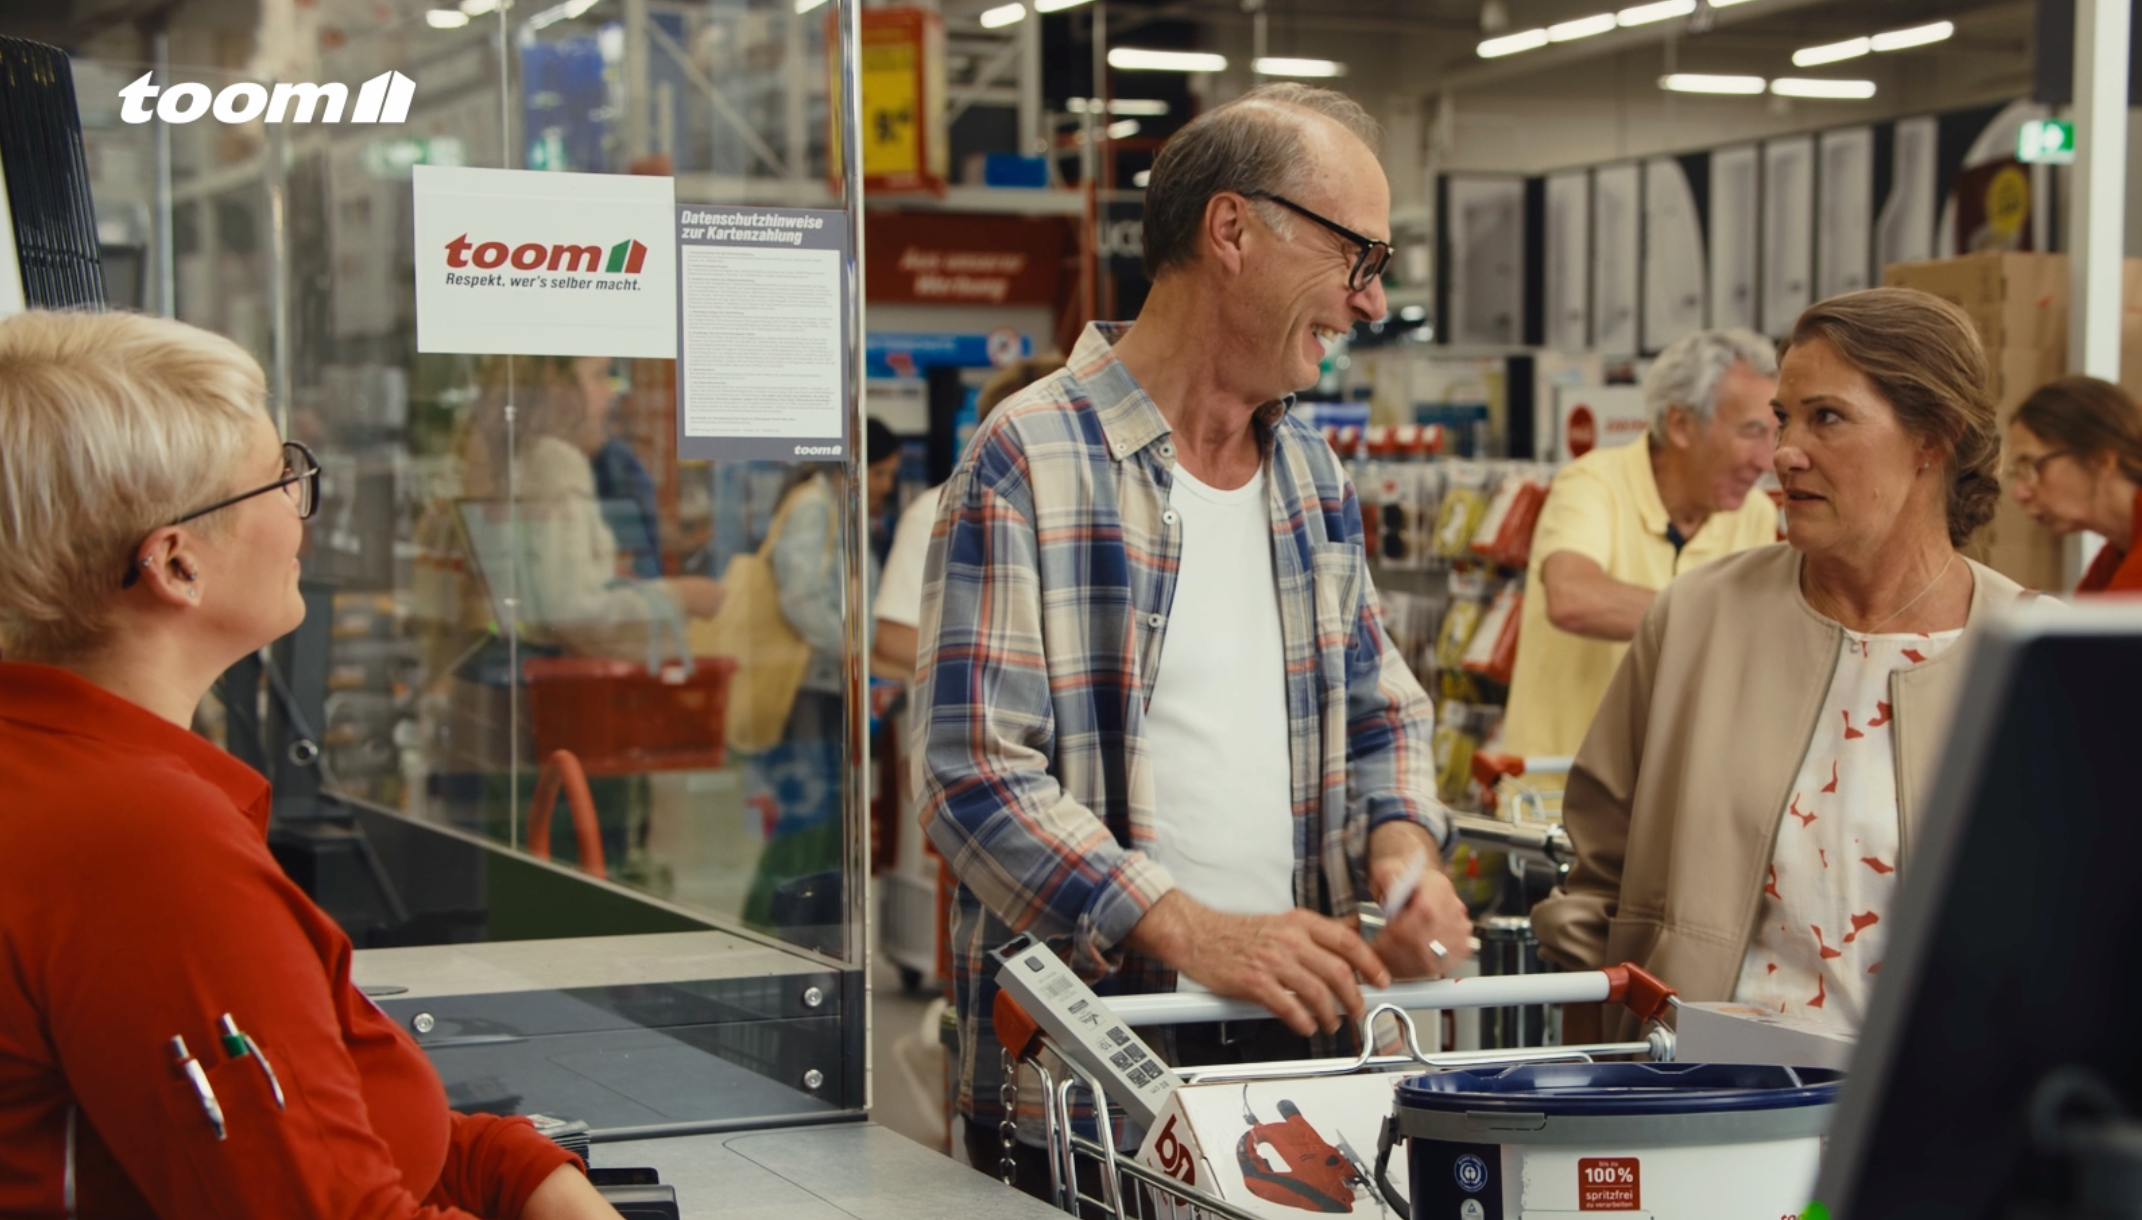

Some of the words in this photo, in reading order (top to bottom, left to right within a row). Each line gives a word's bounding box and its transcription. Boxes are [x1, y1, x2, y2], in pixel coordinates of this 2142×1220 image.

[681, 210, 824, 230] Datenschutzhinweise
[681, 227, 705, 239] zur
[706, 226, 803, 245] Kartenzahlung
[444, 232, 603, 273] toom
[510, 276, 547, 288] wer's
[550, 276, 593, 290] selber
[595, 279, 641, 291] macht.
[794, 445, 832, 455] toom
[1585, 1190, 1634, 1201] spritzfrei
